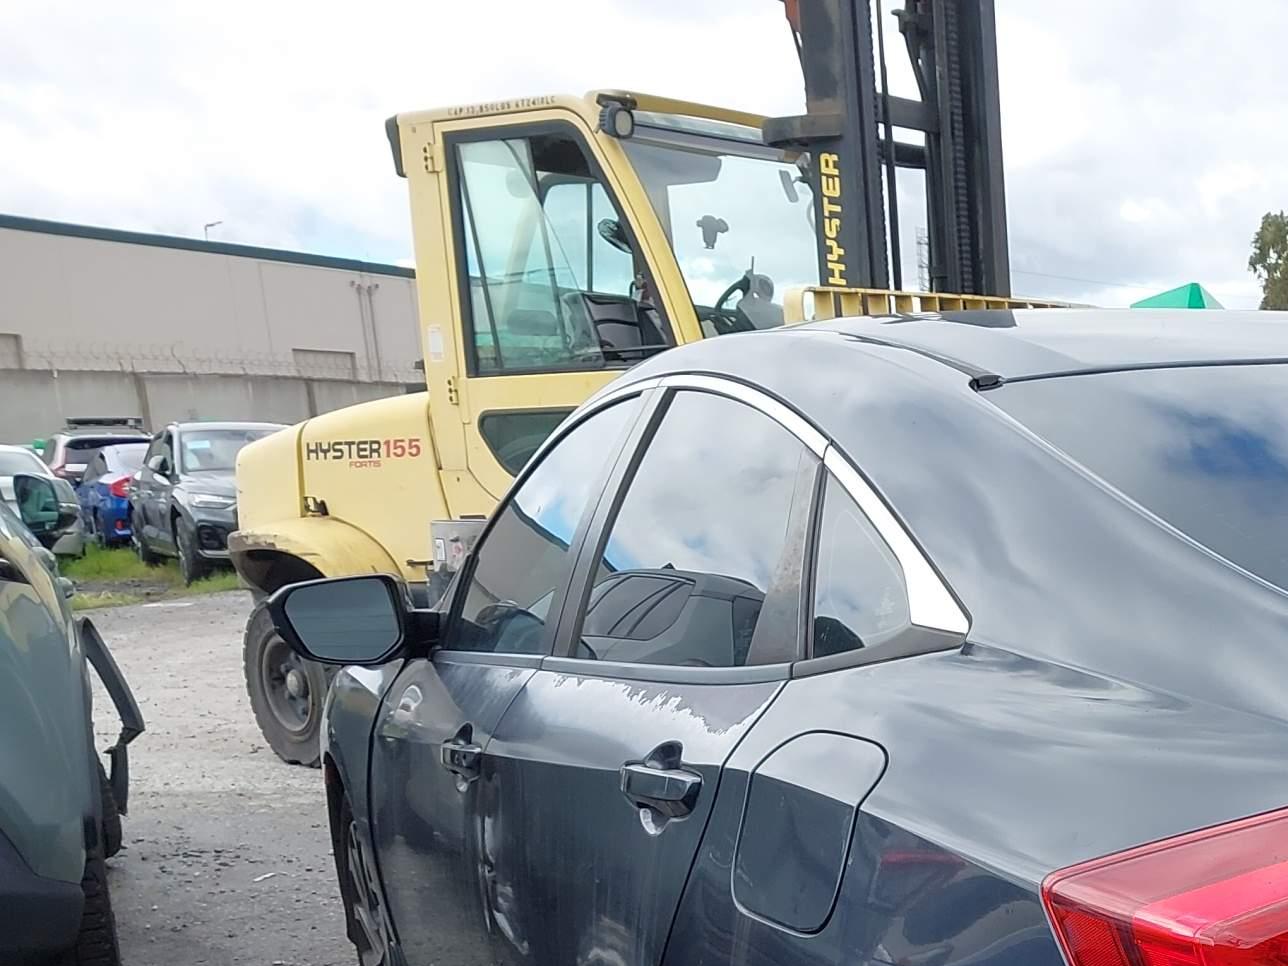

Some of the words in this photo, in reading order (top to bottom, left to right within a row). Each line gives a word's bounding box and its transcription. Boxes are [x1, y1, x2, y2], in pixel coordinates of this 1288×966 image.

[820, 152, 847, 286] HYSTER
[306, 440, 381, 460] HYSTER
[383, 438, 421, 458] 155
[349, 459, 382, 469] FORTIS
